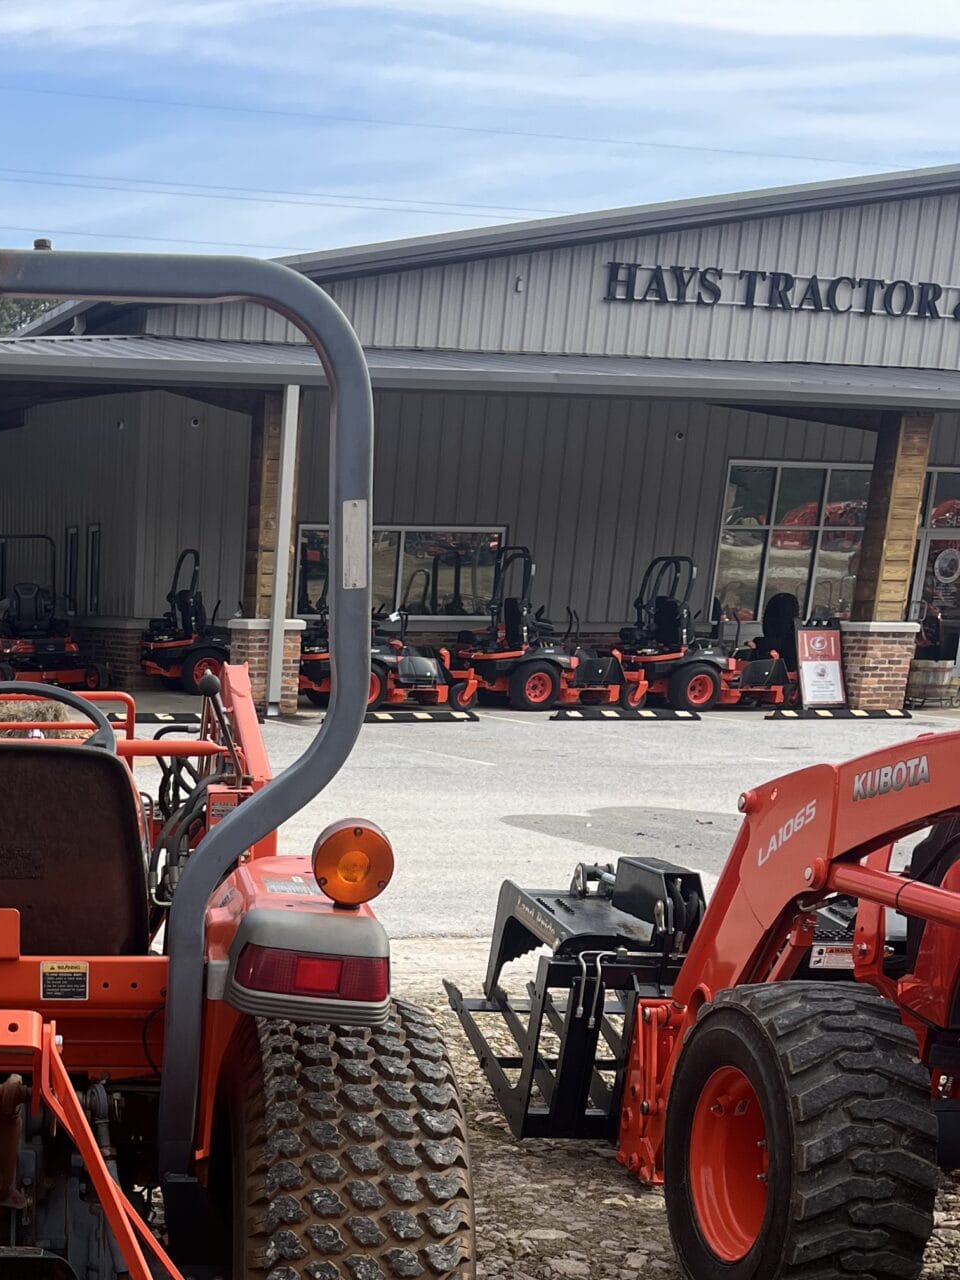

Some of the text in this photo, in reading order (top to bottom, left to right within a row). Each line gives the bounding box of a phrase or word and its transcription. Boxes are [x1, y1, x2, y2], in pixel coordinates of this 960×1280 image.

[603, 262, 943, 320] HAYS TRACTOR
[853, 754, 930, 802] KUBOTA
[757, 799, 817, 867] LA1065
